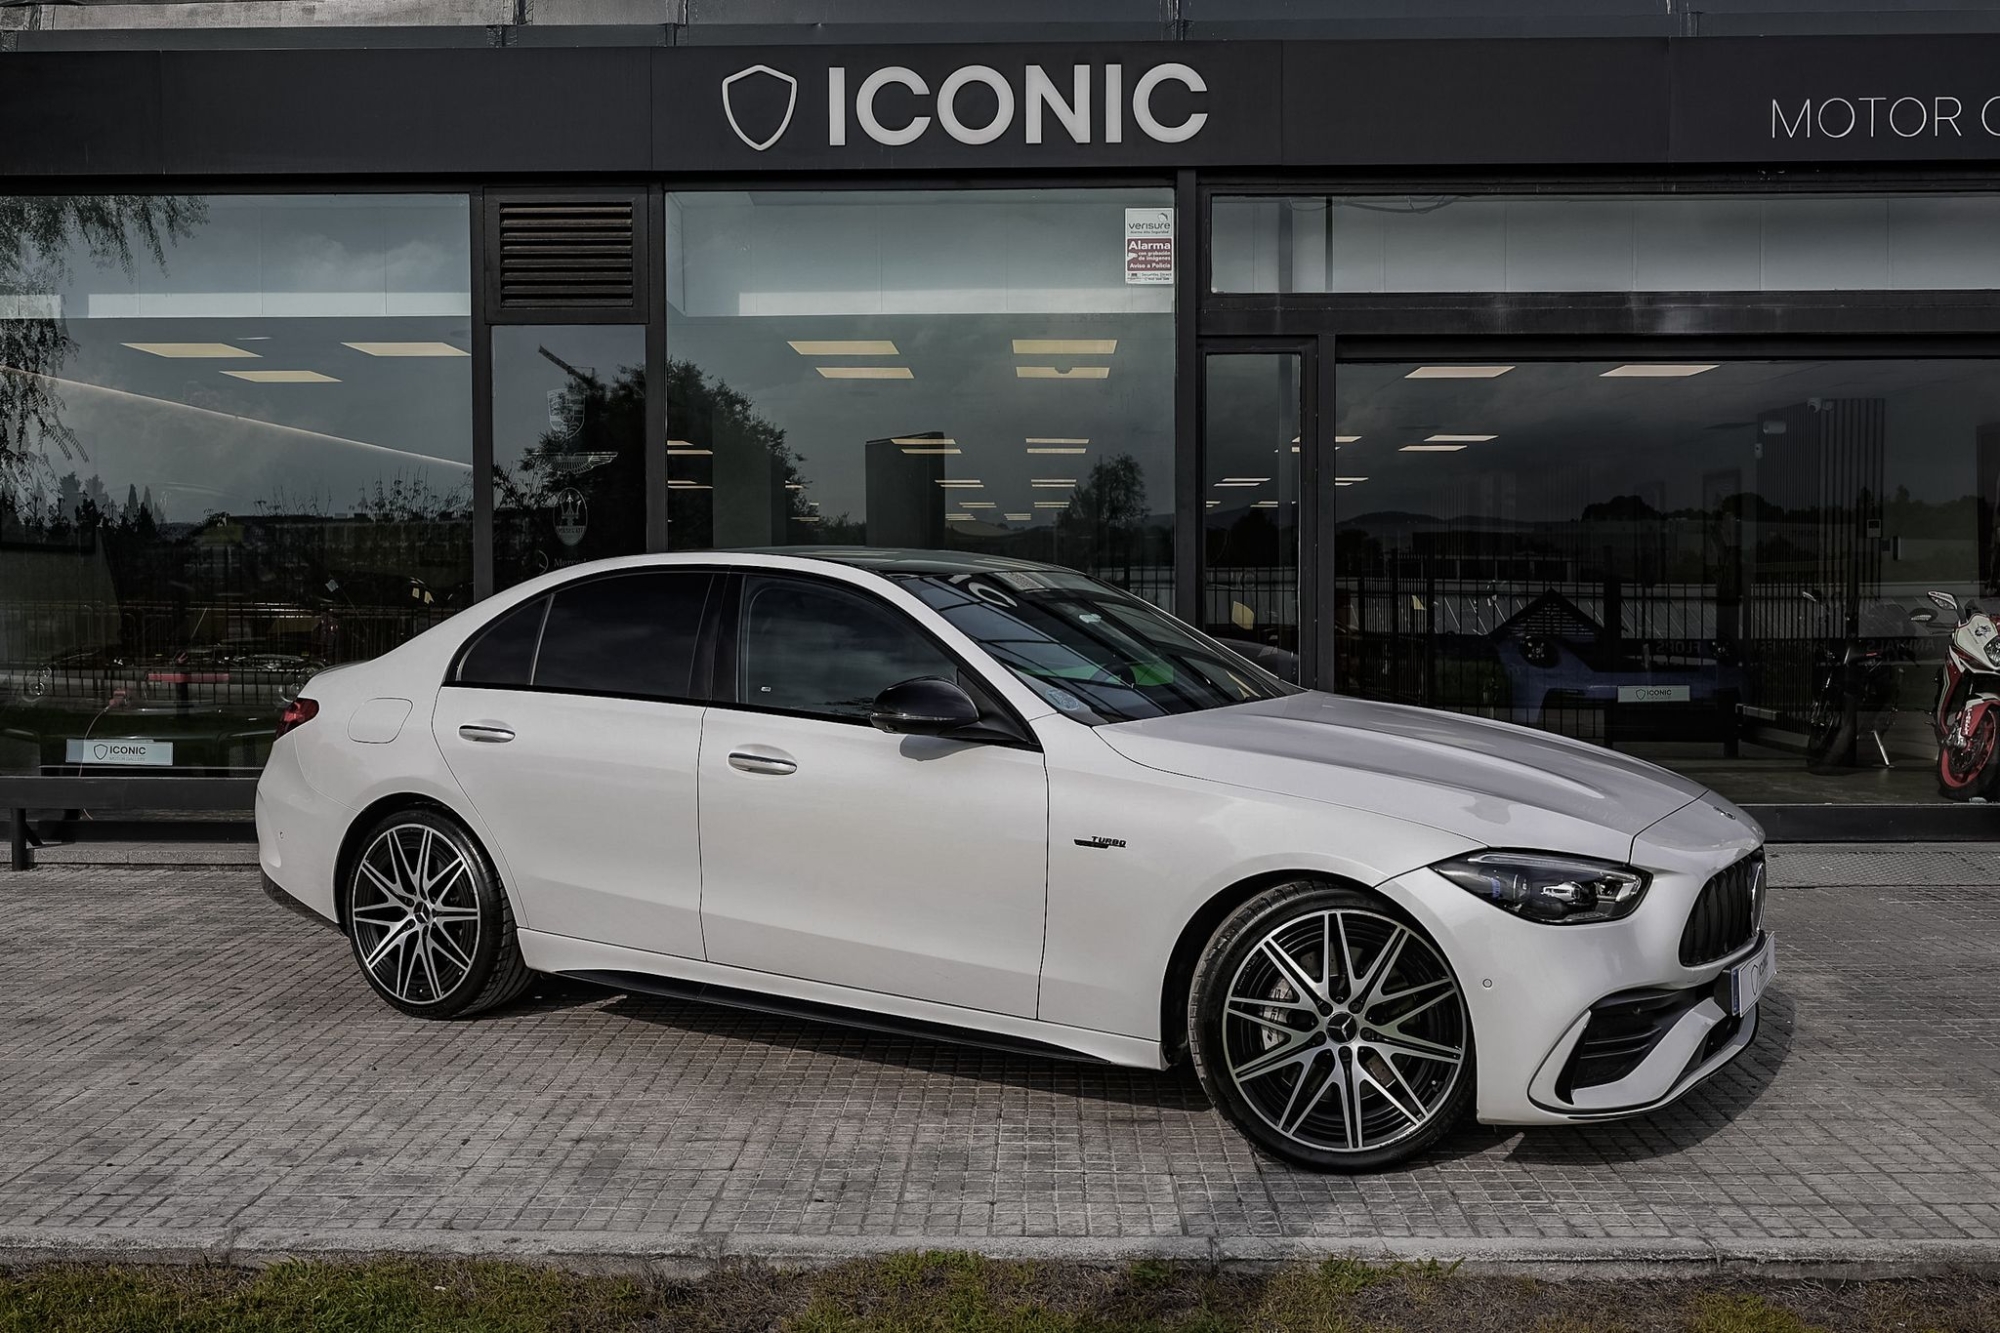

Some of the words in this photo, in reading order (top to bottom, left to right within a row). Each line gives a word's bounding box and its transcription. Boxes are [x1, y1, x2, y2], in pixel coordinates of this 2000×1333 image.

[828, 62, 1209, 147] ICONIC
[1770, 95, 1963, 139] MOTOR
[1128, 240, 1171, 250] Alarma
[110, 746, 146, 755] ICONIC
[1092, 836, 1126, 846] TURBO
